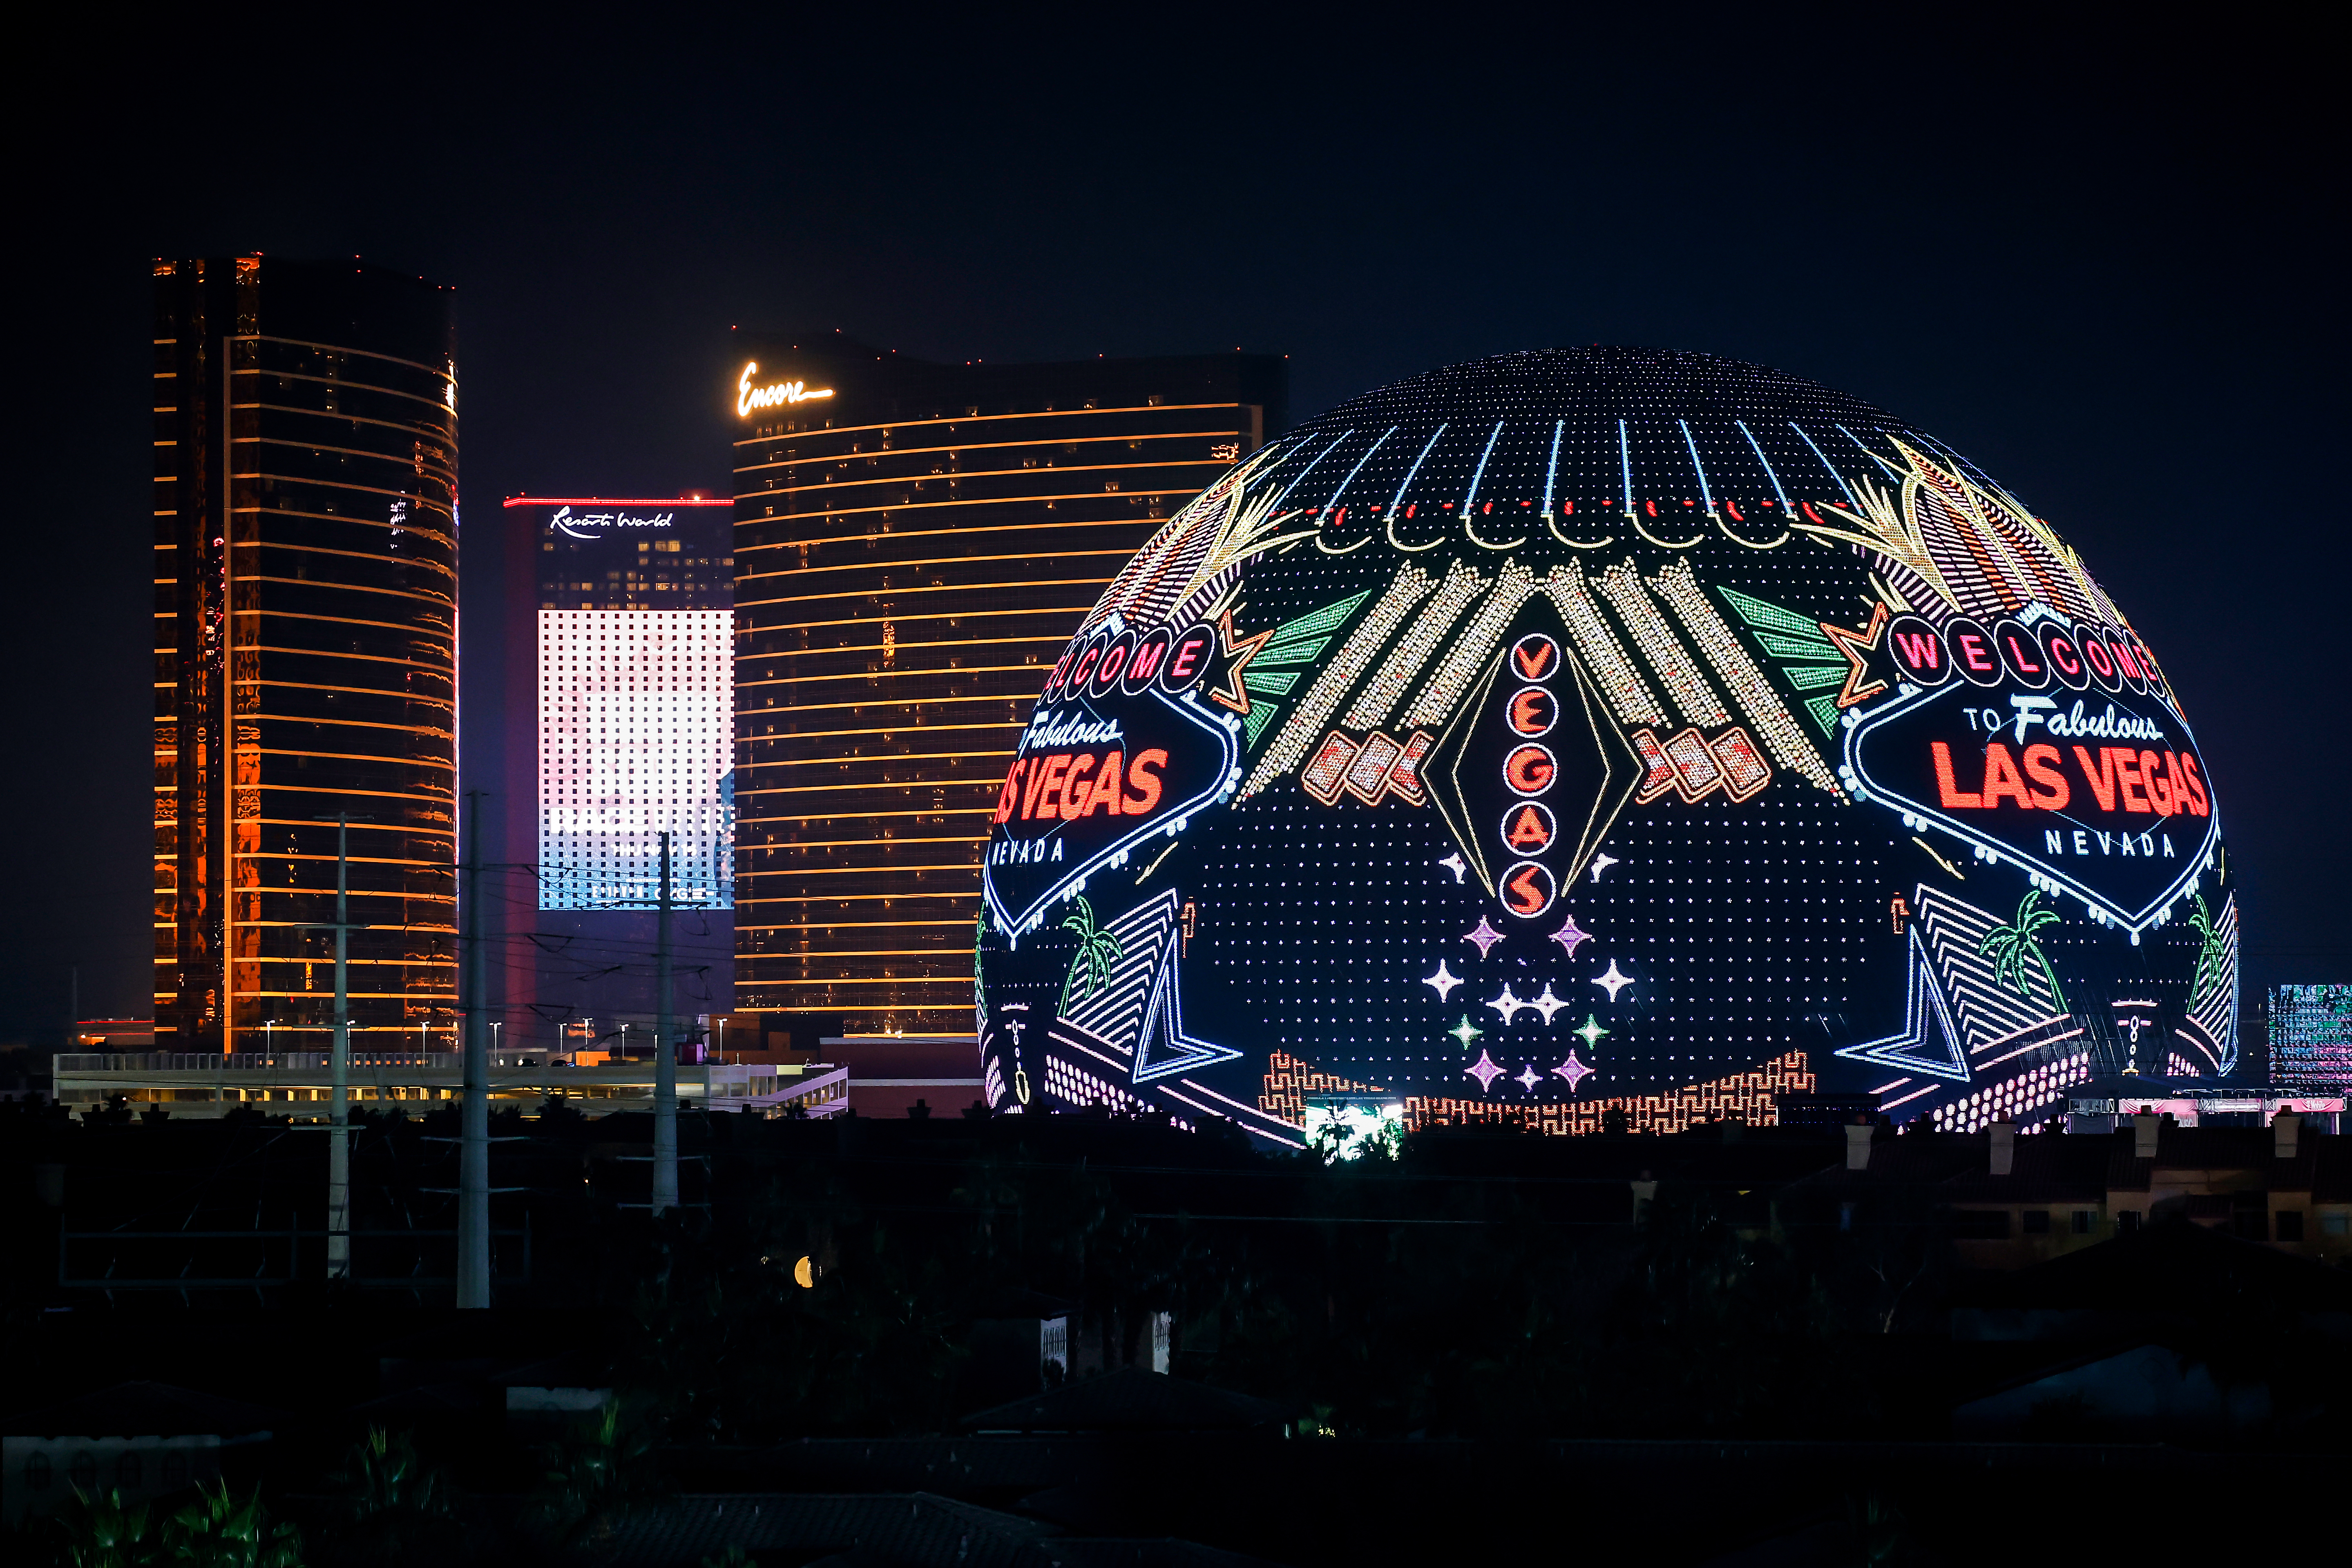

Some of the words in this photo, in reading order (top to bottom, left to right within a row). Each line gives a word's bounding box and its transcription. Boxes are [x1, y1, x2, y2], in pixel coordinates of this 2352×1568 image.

[738, 362, 834, 416] Encore
[550, 505, 614, 539] Resorts
[617, 511, 673, 527] World
[1896, 633, 2158, 681] WELCOME
[1963, 708, 2001, 731] TO
[2010, 692, 2164, 745] Fabulous
[1021, 748, 1168, 821] VEGAS
[1507, 643, 1552, 914] VEGAS
[1930, 742, 2070, 811] LAS
[2073, 745, 2209, 817] VEGAS
[550, 807, 649, 833] RACE
[2045, 829, 2175, 857] NEVADA
[610, 844, 641, 856] THU
[992, 838, 1062, 866] NEVADA
